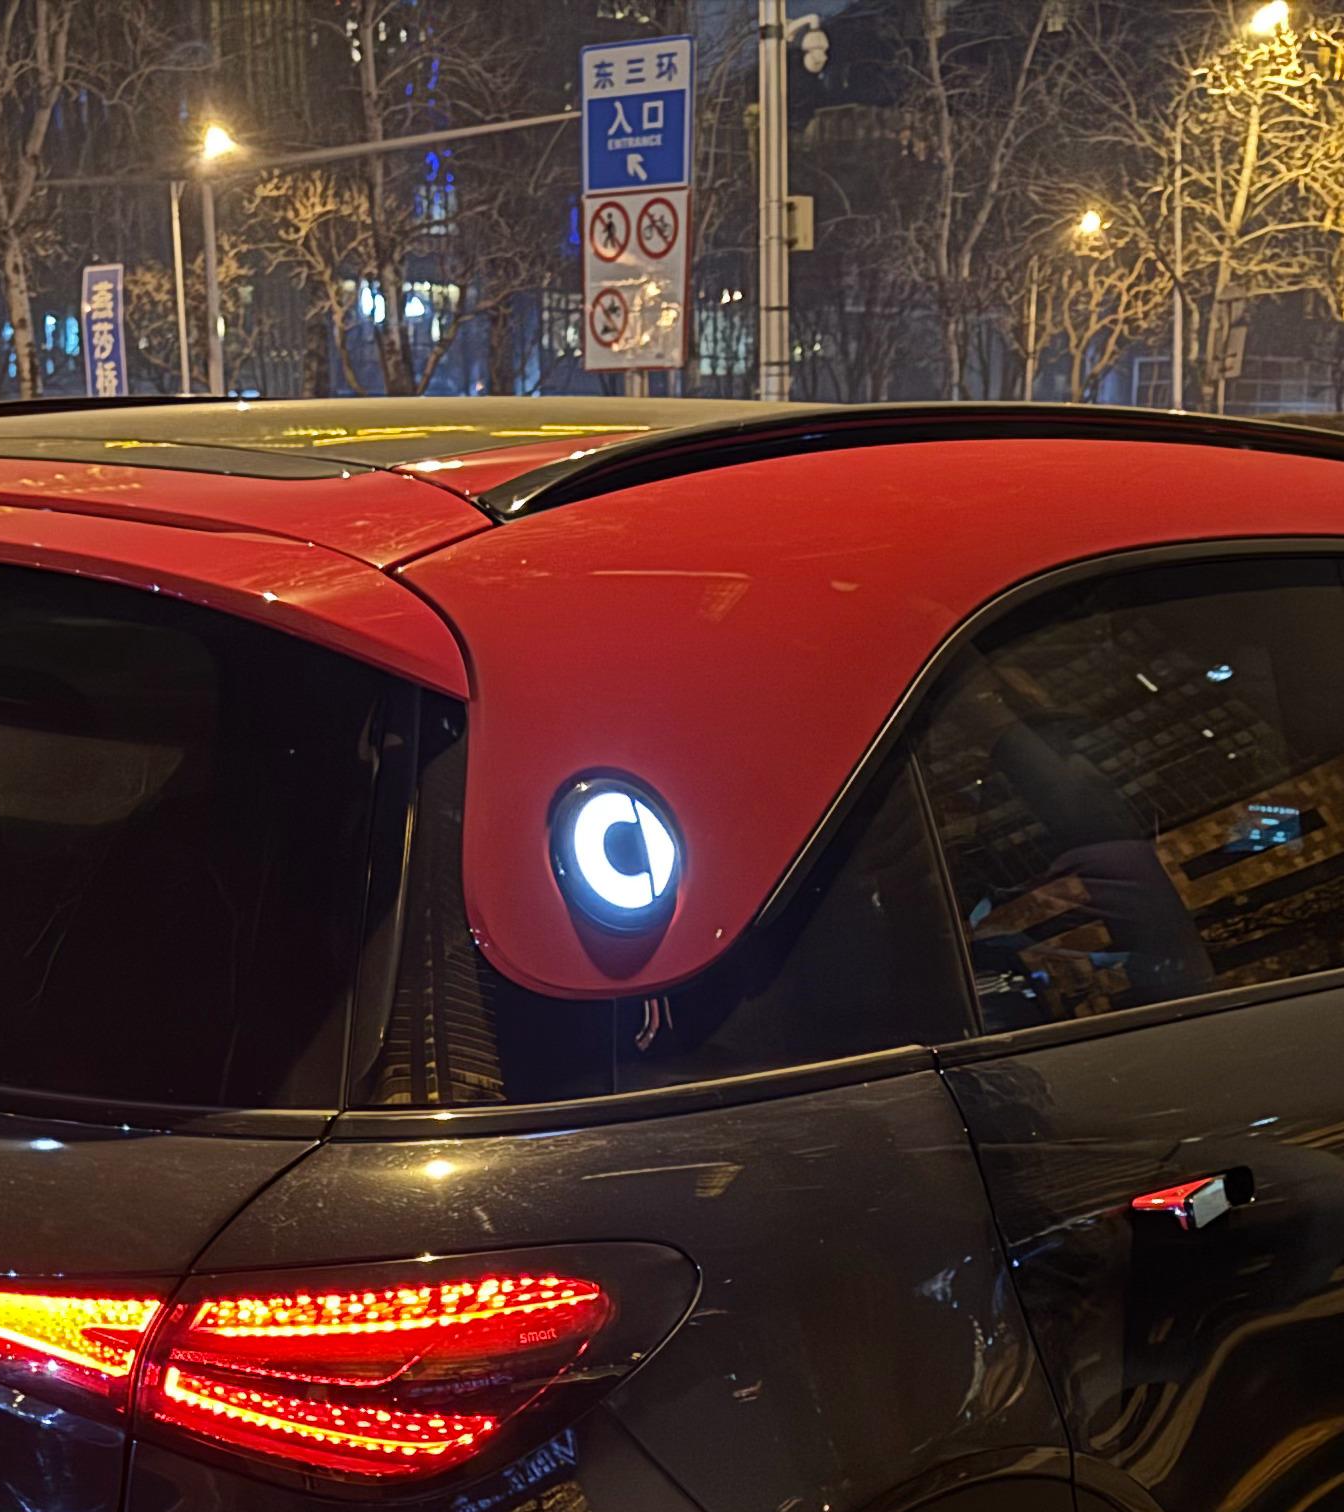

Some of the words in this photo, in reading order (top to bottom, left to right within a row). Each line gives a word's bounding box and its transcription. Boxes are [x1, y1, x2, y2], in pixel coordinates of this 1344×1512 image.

[593, 52, 678, 90] 东三环
[607, 100, 665, 136] 入口
[607, 134, 663, 151] ENTRANCE
[519, 1327, 557, 1344] smart
